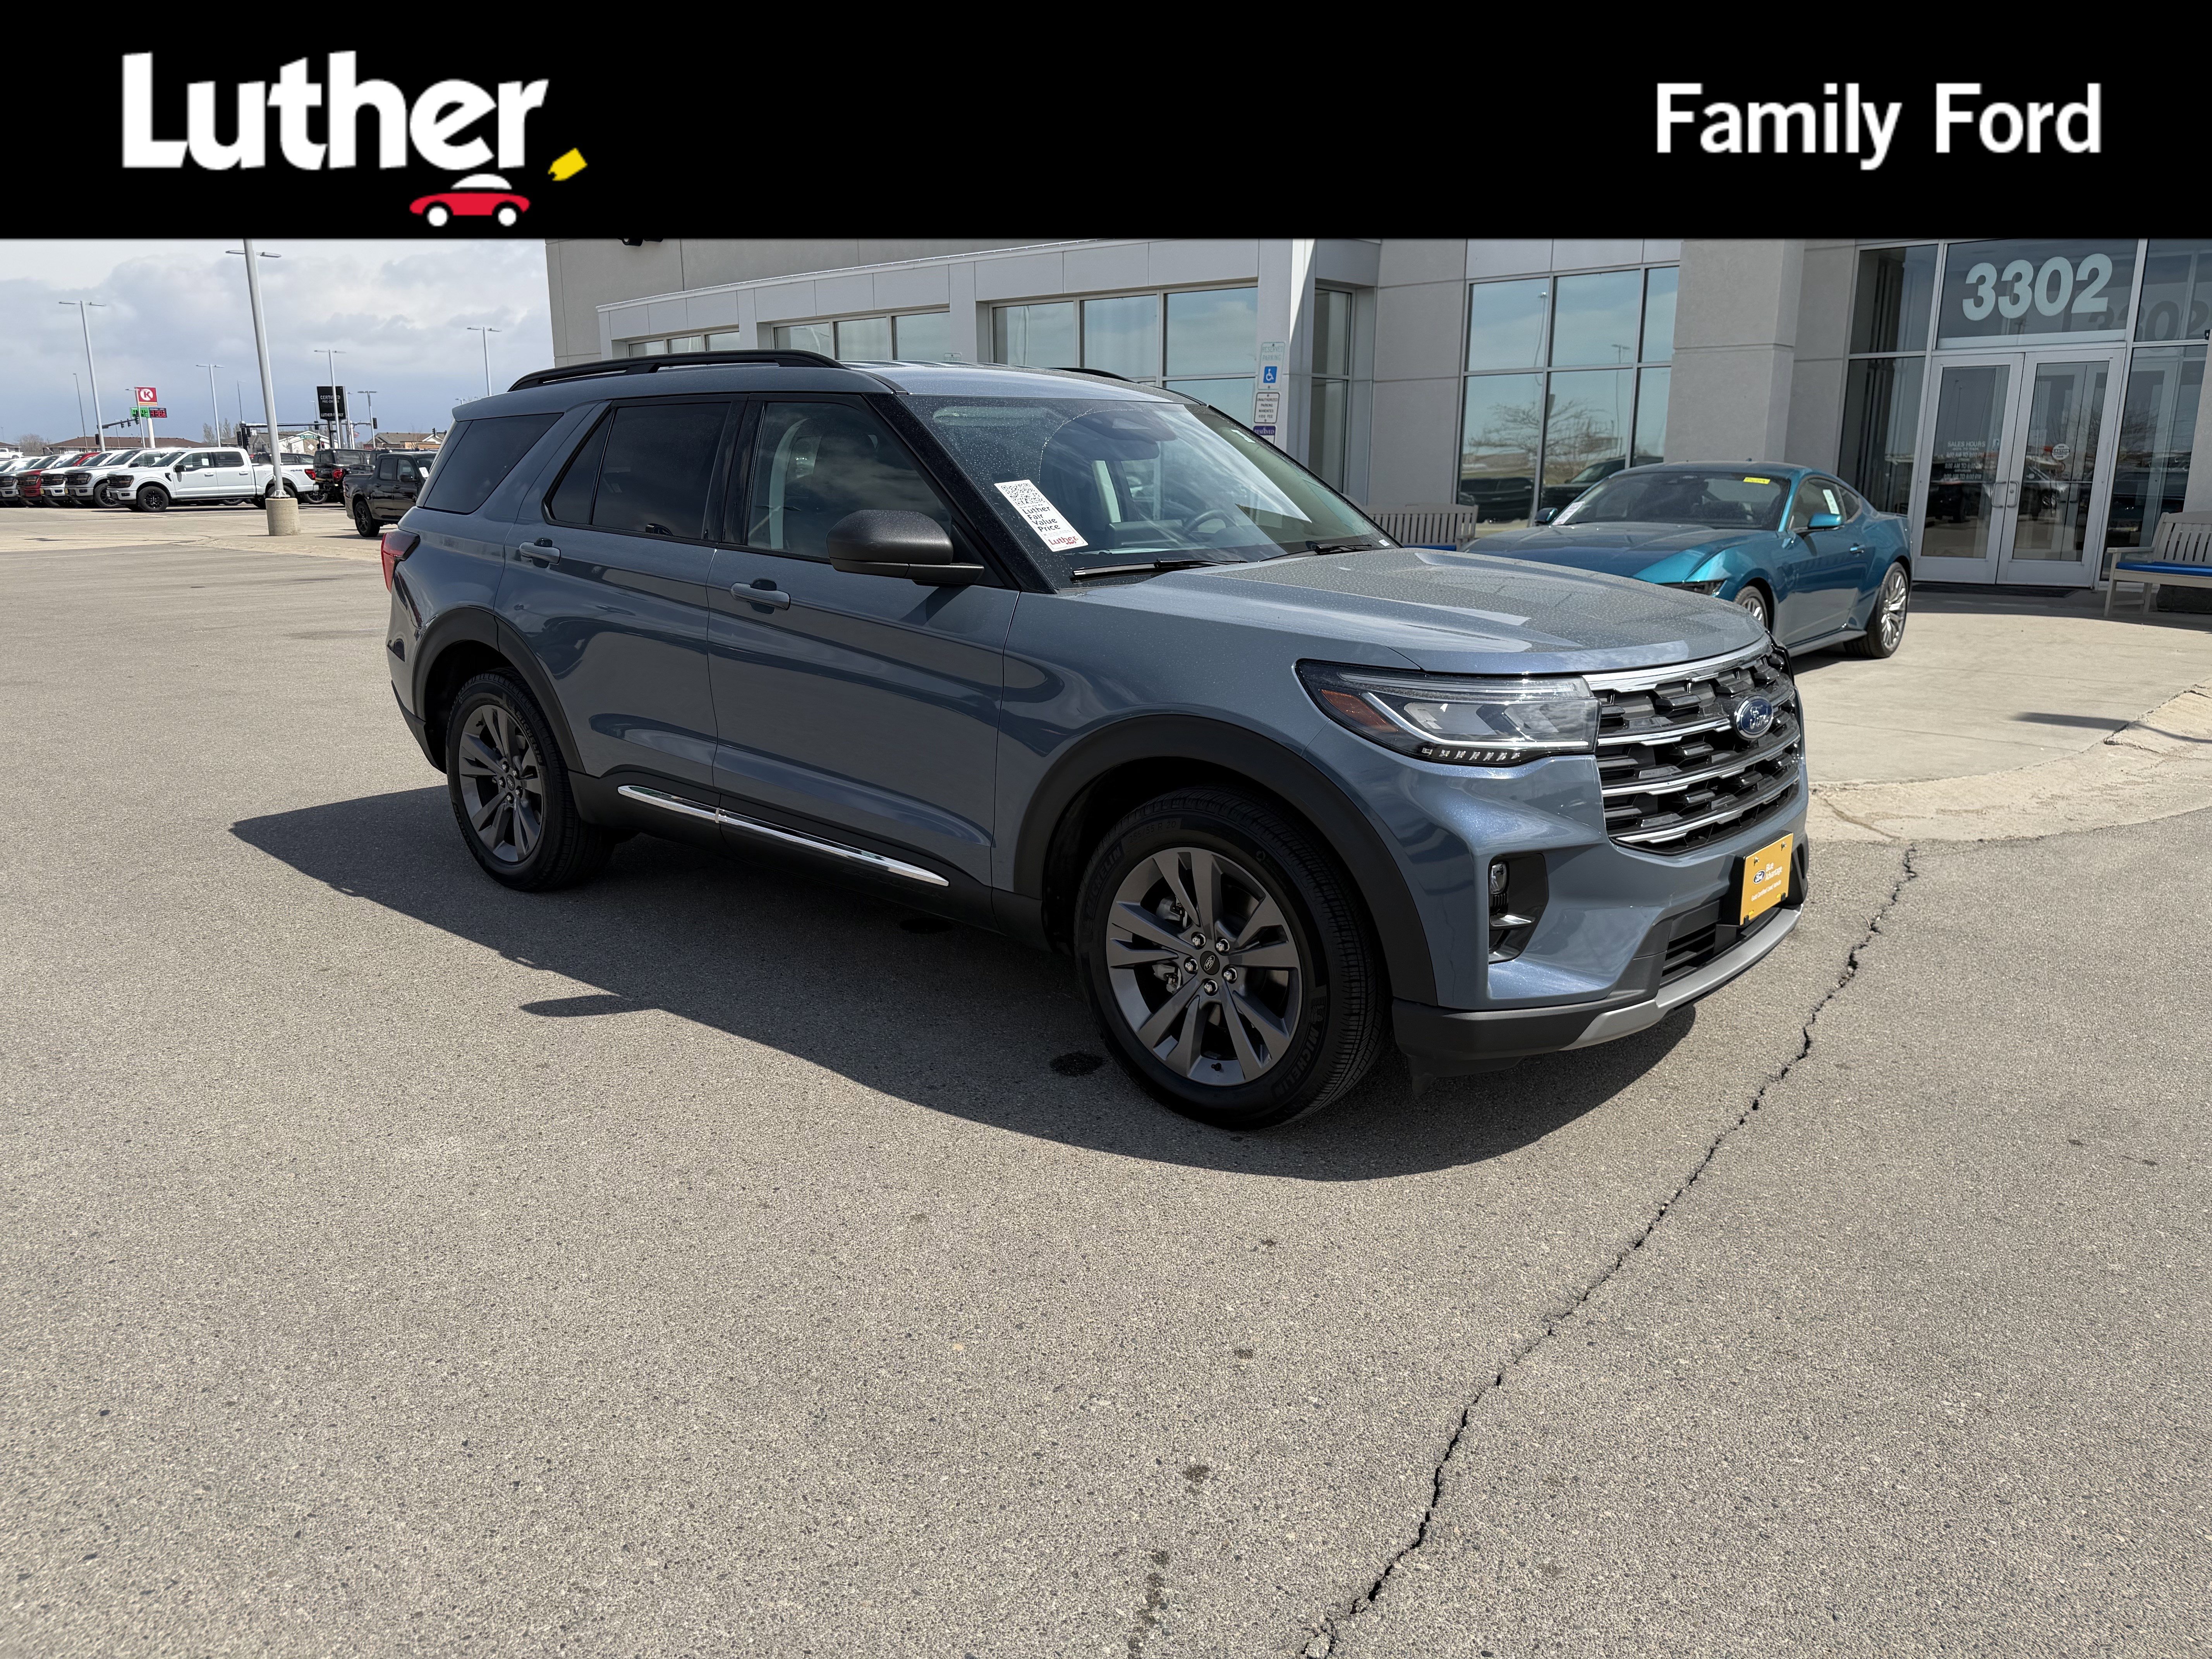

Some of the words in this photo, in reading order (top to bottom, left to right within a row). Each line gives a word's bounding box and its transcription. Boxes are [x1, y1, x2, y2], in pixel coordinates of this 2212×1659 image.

[1962, 253, 2113, 321] 3302
[1048, 536, 1078, 545] Luther
[1129, 825, 1155, 844] 255/55
[1166, 821, 1176, 829] 20
[1764, 866, 1783, 882] Advantage
[1765, 862, 1774, 872] Blue
[1085, 846, 1122, 917] MICHELIN
[1274, 1026, 1319, 1097] MICHELIN
